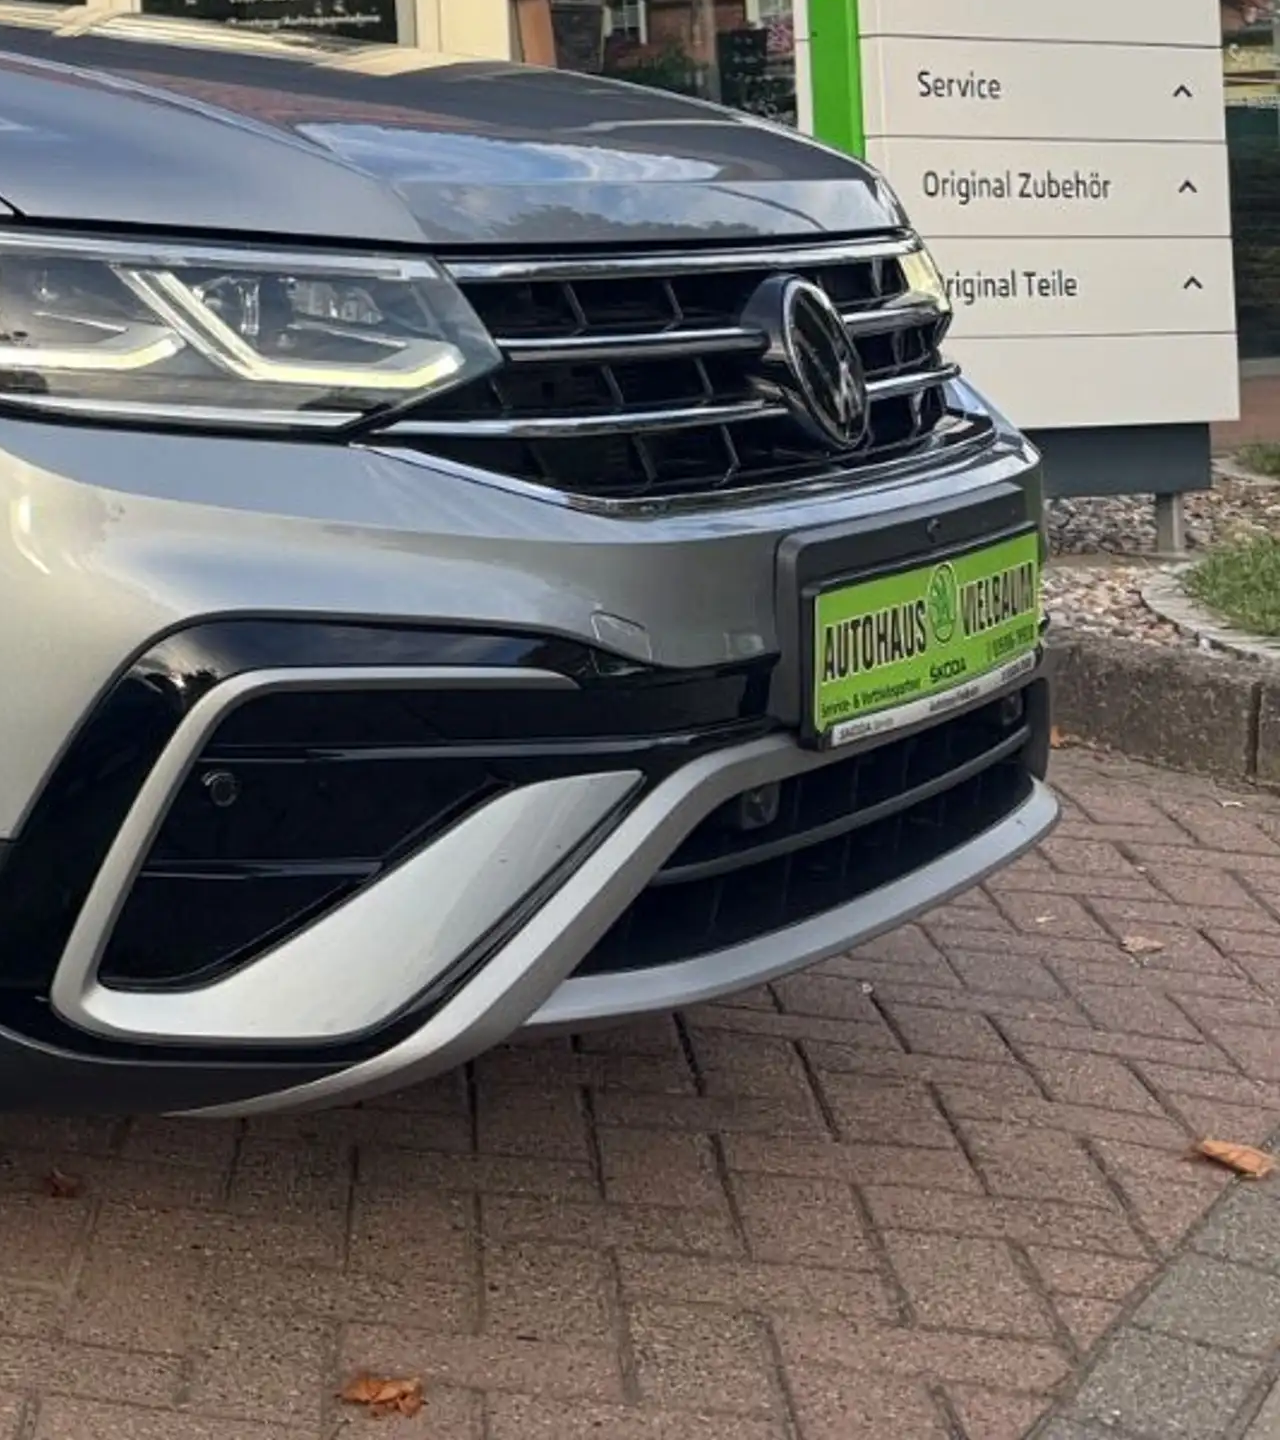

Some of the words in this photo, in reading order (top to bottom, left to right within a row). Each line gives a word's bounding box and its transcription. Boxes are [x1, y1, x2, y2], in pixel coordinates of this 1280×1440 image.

[917, 70, 1002, 100] Service
[923, 170, 1010, 204] Original
[1018, 172, 1110, 200] Zubehör
[942, 269, 1017, 306] riginal
[1023, 269, 1078, 297] Teile
[821, 600, 927, 682] AUTOHAUS
[959, 561, 1035, 637] VIELBAUM
